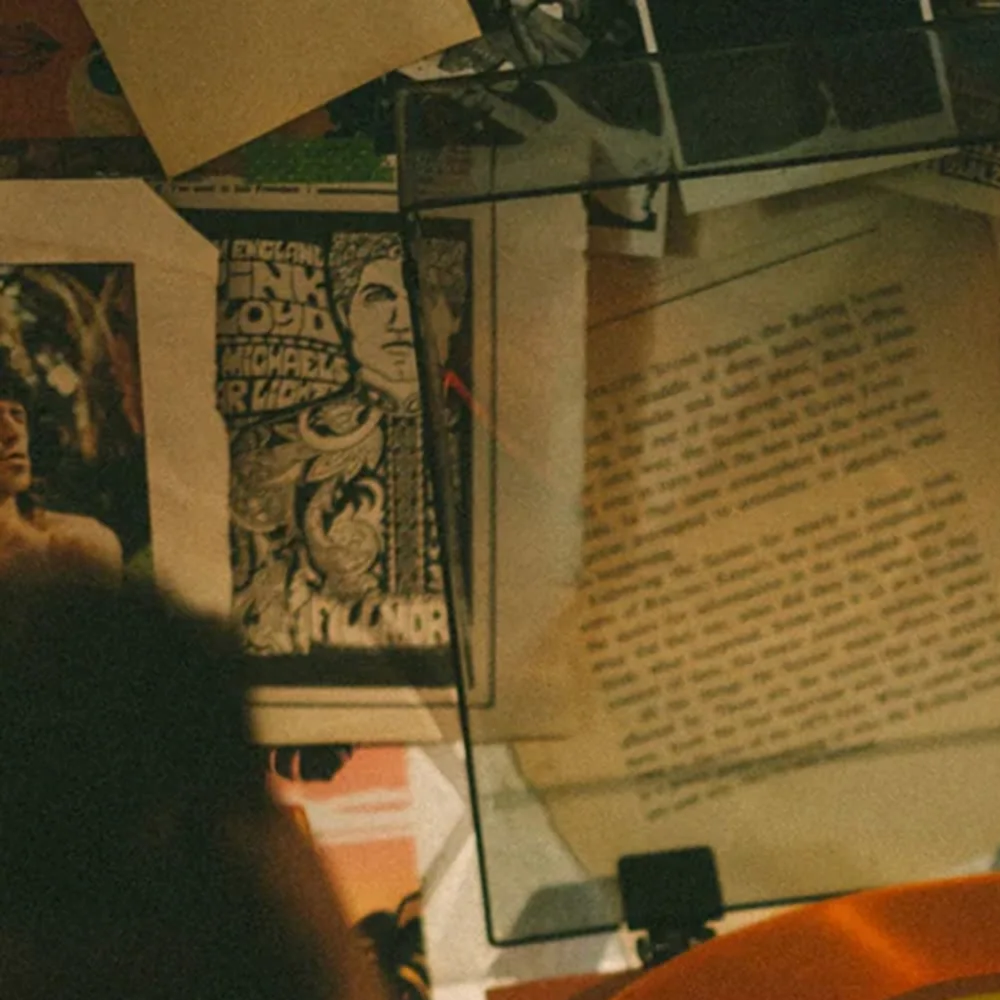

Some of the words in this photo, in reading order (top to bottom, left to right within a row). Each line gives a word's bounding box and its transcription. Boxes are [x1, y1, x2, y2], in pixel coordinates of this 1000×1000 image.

[217, 259, 328, 310] INK
[217, 300, 342, 344] LOYD
[311, 593, 450, 646] FILLMOR
